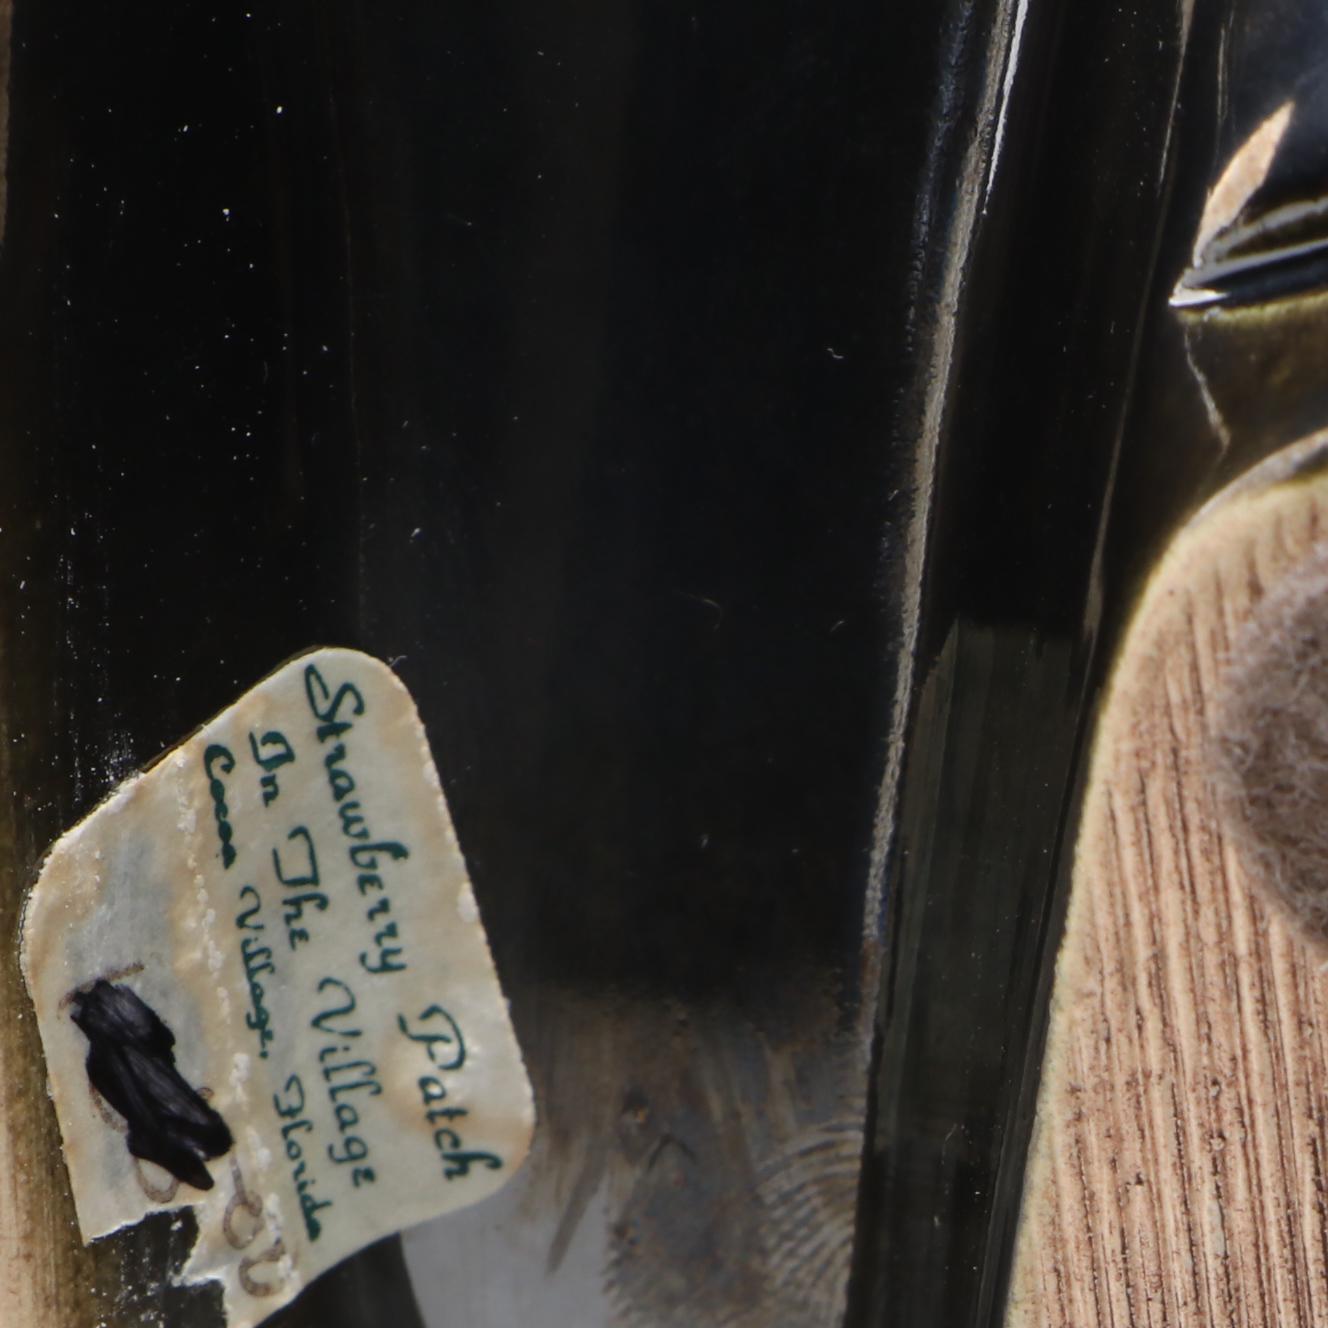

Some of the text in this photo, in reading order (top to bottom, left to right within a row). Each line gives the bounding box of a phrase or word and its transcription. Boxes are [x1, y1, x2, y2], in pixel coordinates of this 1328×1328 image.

[249, 731, 383, 1187] In The Village
[305, 664, 503, 1181] Strawberry Patch
[273, 1074, 332, 1242] Florida
